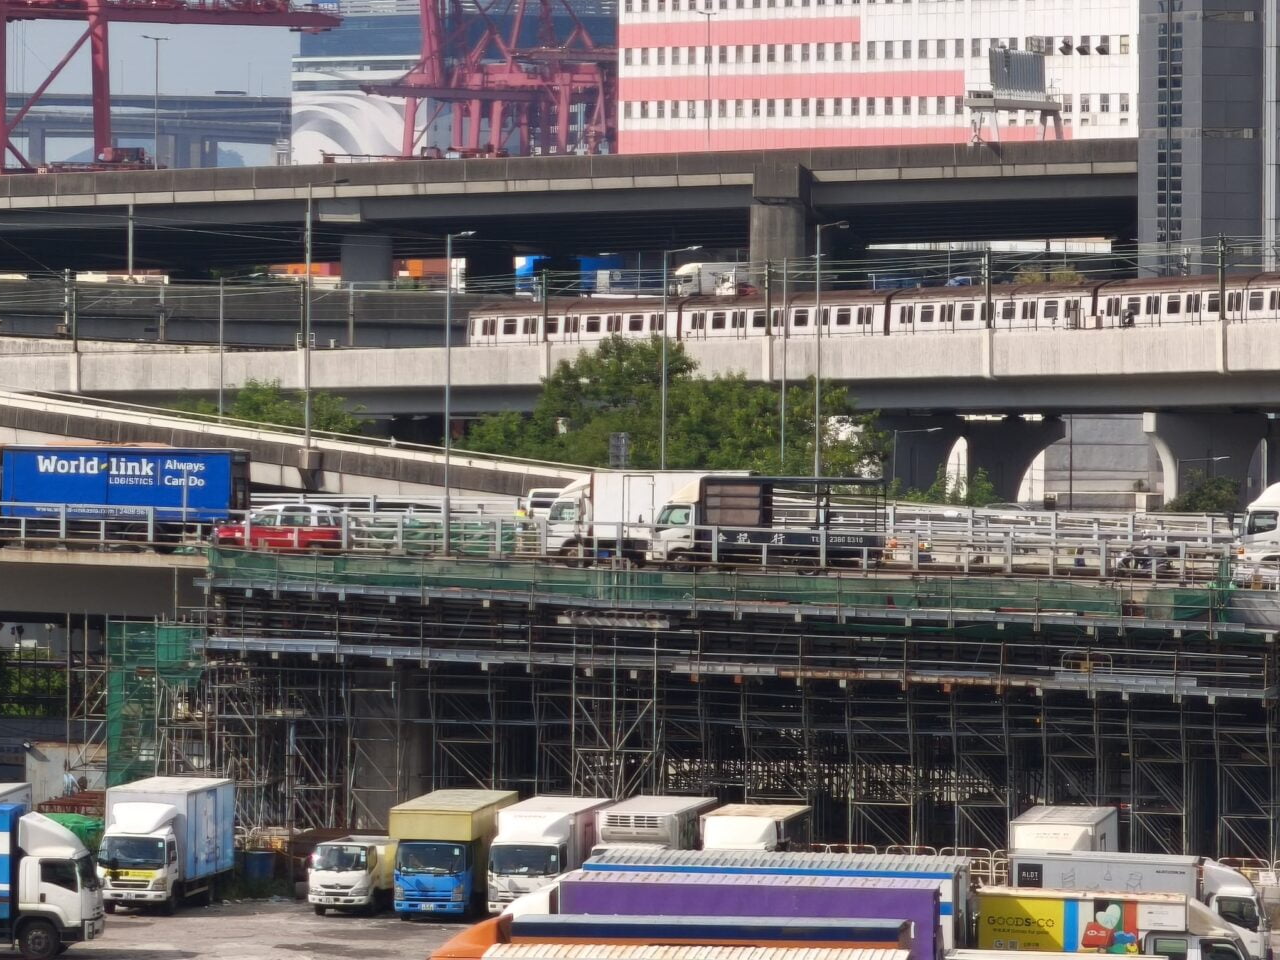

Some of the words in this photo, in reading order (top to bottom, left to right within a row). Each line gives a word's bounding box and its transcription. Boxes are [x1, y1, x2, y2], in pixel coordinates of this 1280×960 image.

[165, 459, 205, 472] Always
[109, 476, 153, 486] LOGISTICS
[164, 475, 186, 487] Can
[188, 476, 205, 487] Do
